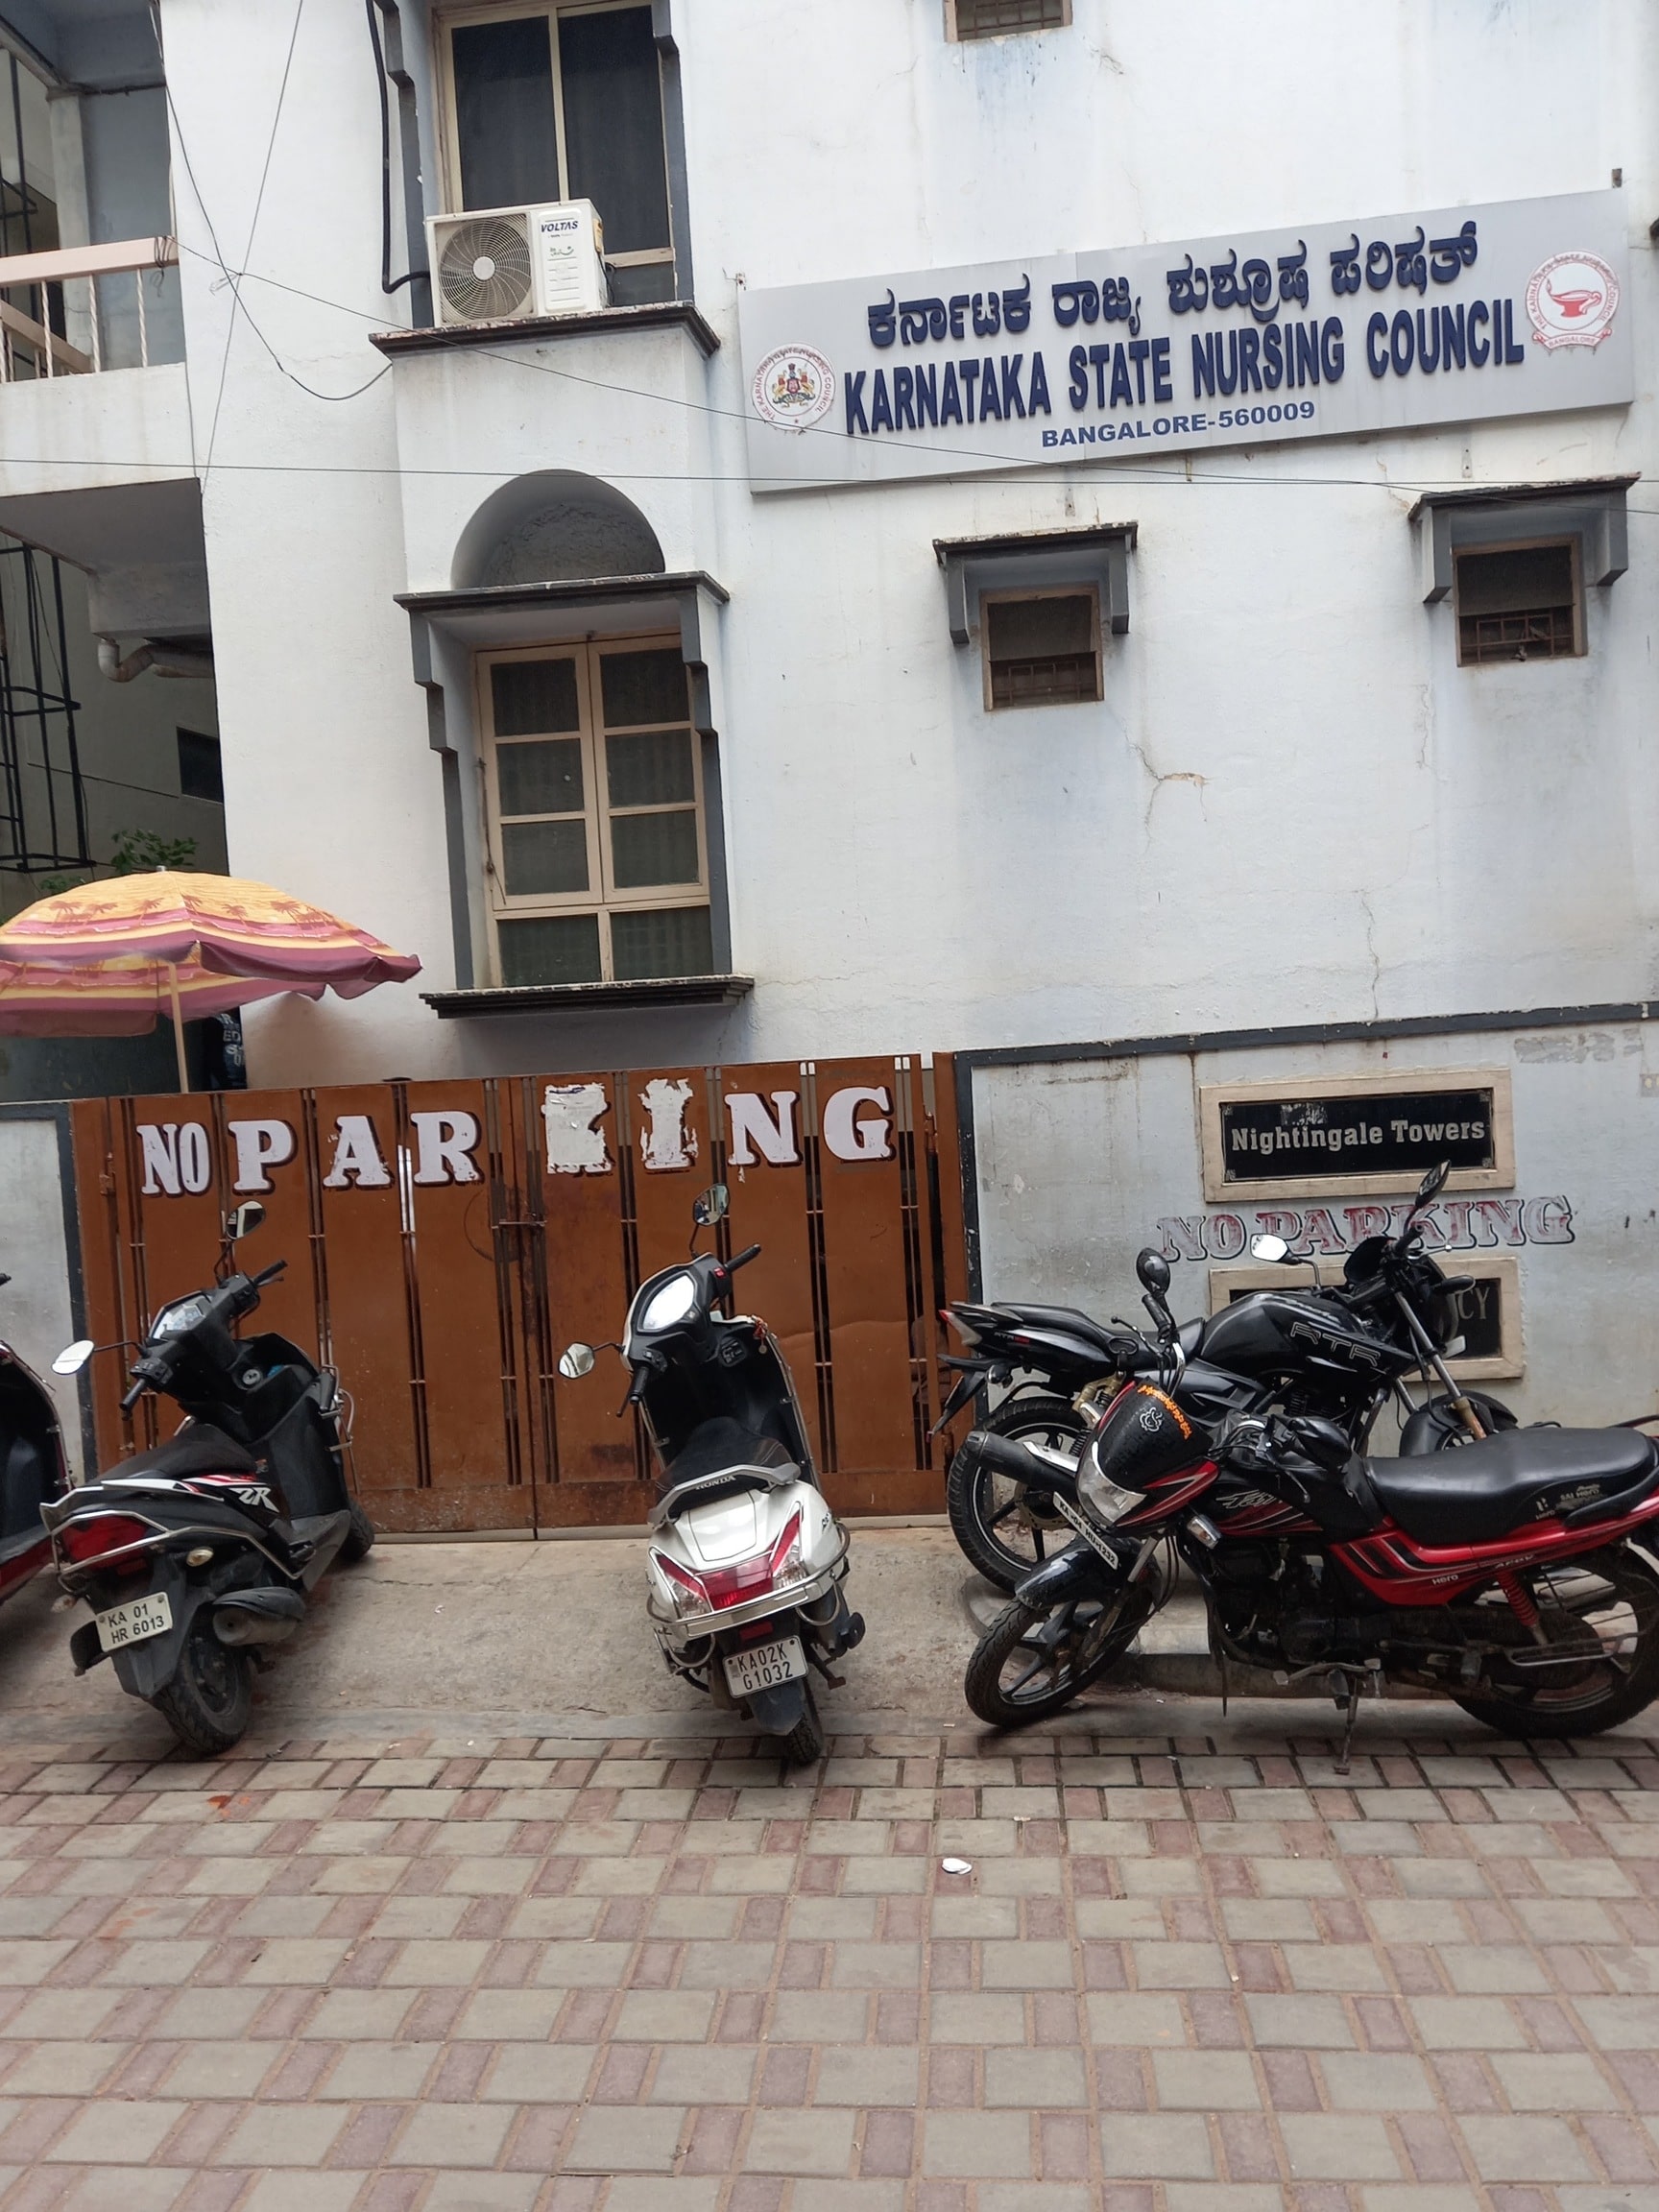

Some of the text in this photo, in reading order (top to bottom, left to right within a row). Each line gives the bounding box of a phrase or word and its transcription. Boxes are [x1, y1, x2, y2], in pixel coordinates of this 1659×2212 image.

[541, 220, 579, 233] VOLTAS
[868, 273, 1031, 349] ಕರ್ನಾಟಕ
[1051, 276, 1142, 336] ರಾಜ್ಯ
[1330, 221, 1478, 296] ಪರಿಷತ್
[844, 299, 1525, 436] KARNATAKA STATE NURSING COUNCIL
[1042, 399, 1315, 448] BANGALORE-560009
[1231, 1118, 1485, 1155] Nightingale Towers
[136, 1121, 212, 1196] NO
[1157, 1194, 1575, 1262] NO PARKING
[1289, 1321, 1382, 1367] RTR
[1431, 1574, 1458, 1586] Hero
[108, 1602, 149, 1628] KA 01
[111, 1615, 164, 1644] HR 6013
[737, 1643, 787, 1672] KA02K
[742, 1661, 793, 1690] G1032
